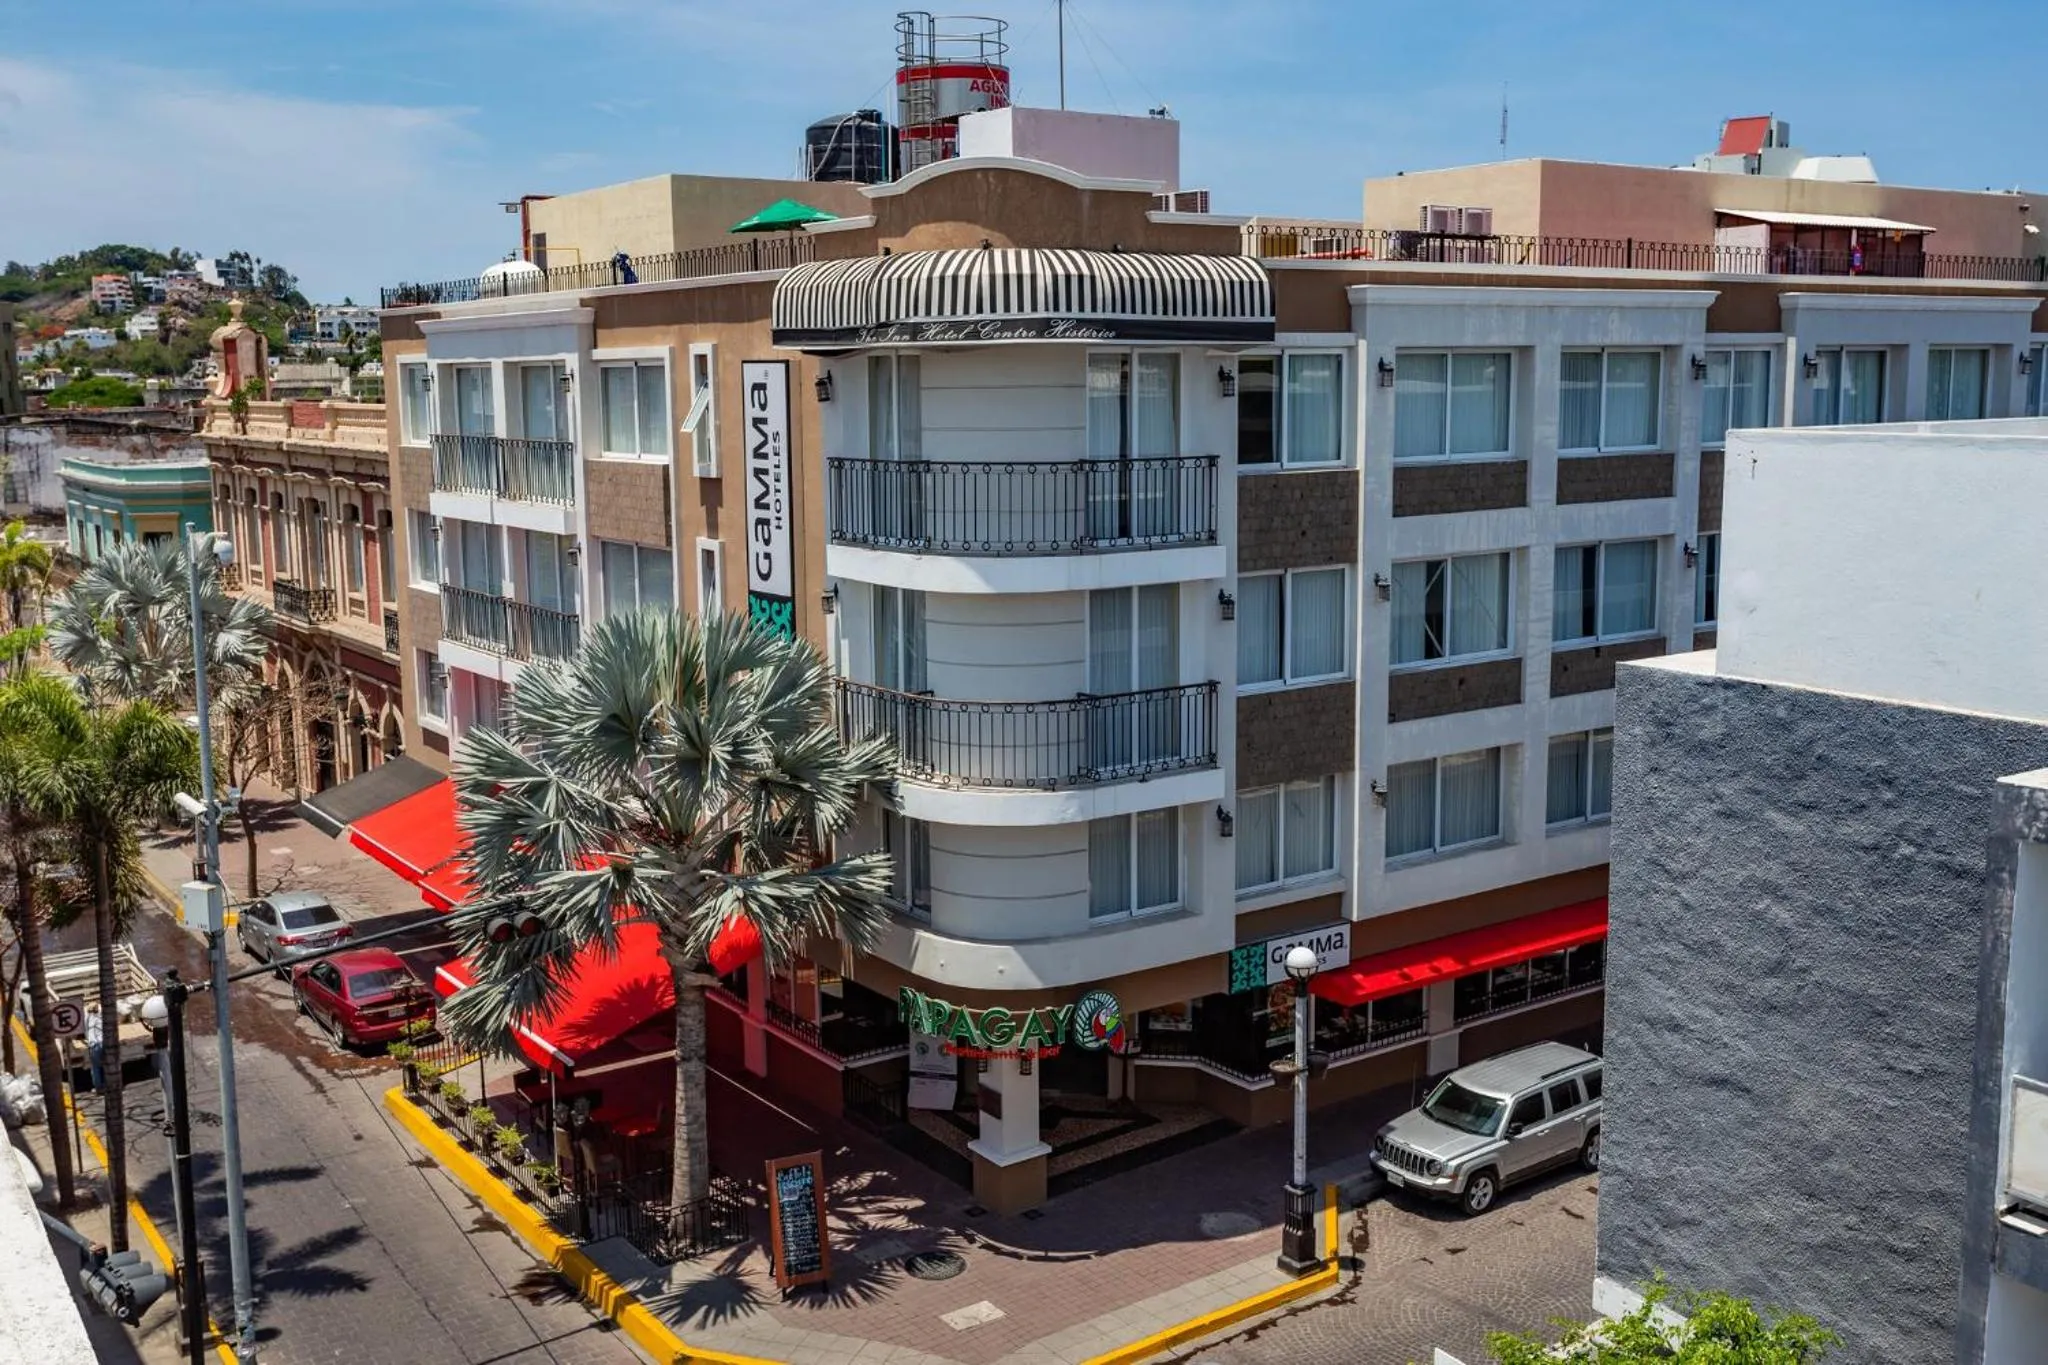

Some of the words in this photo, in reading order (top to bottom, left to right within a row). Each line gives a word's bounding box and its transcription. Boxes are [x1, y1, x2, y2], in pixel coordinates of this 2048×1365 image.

[879, 325, 911, 341] Inn
[917, 321, 974, 341] Hotel
[977, 320, 1037, 339] Centro
[772, 430, 783, 531] HOTELES
